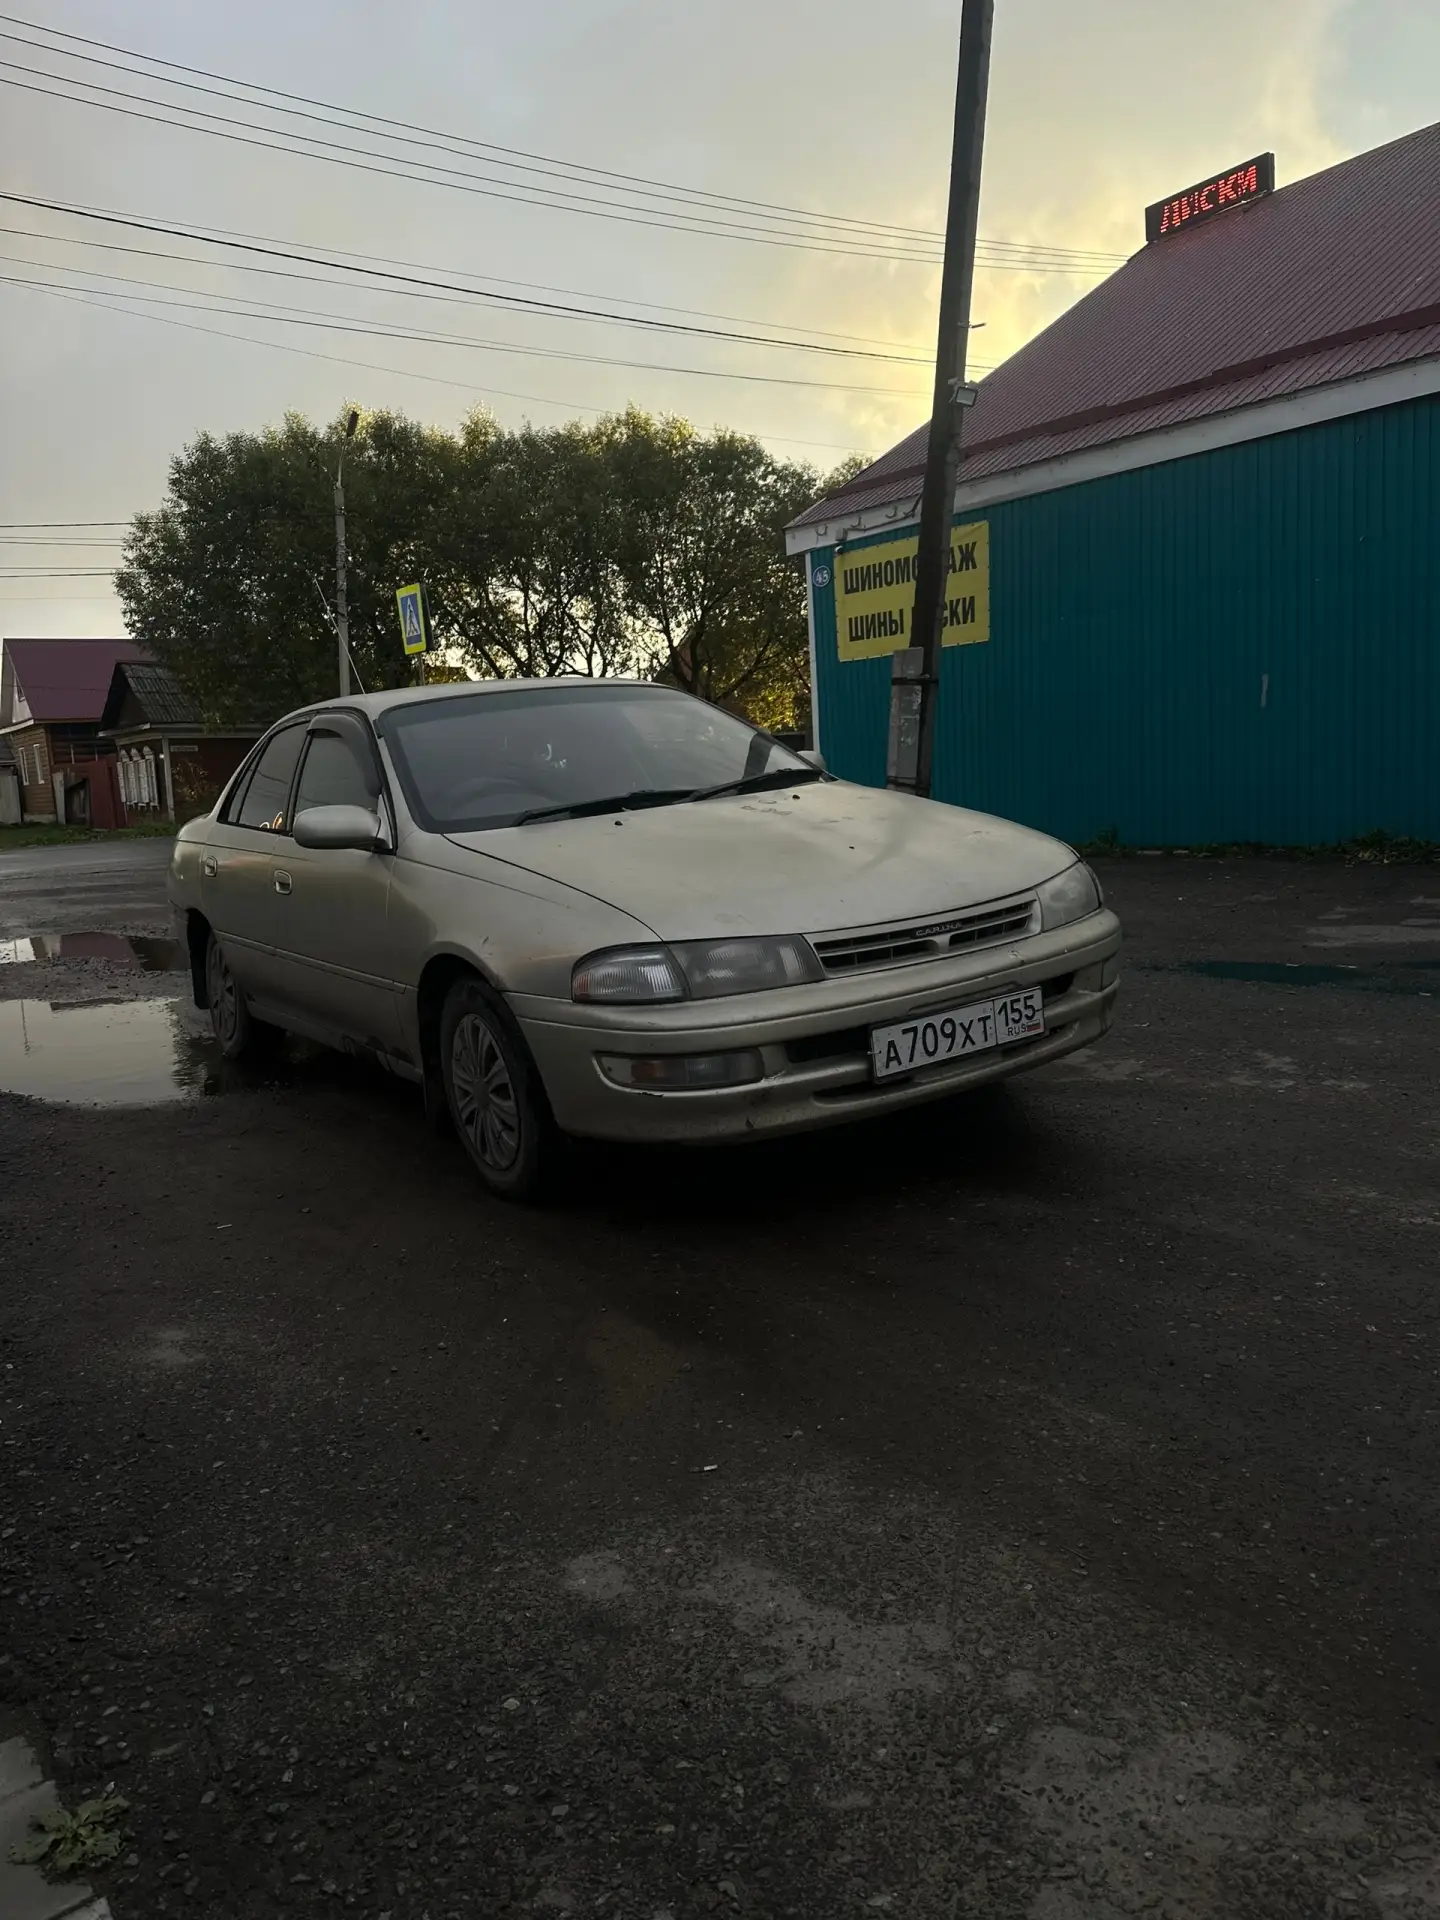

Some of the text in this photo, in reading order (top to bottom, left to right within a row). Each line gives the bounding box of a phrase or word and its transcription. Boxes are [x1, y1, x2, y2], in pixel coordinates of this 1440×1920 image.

[843, 541, 978, 595] ШИНОМОАЖ
[848, 608, 905, 642] ШИНЫ
[997, 994, 1036, 1027] 155
[1007, 1024, 1027, 1036] RUS
